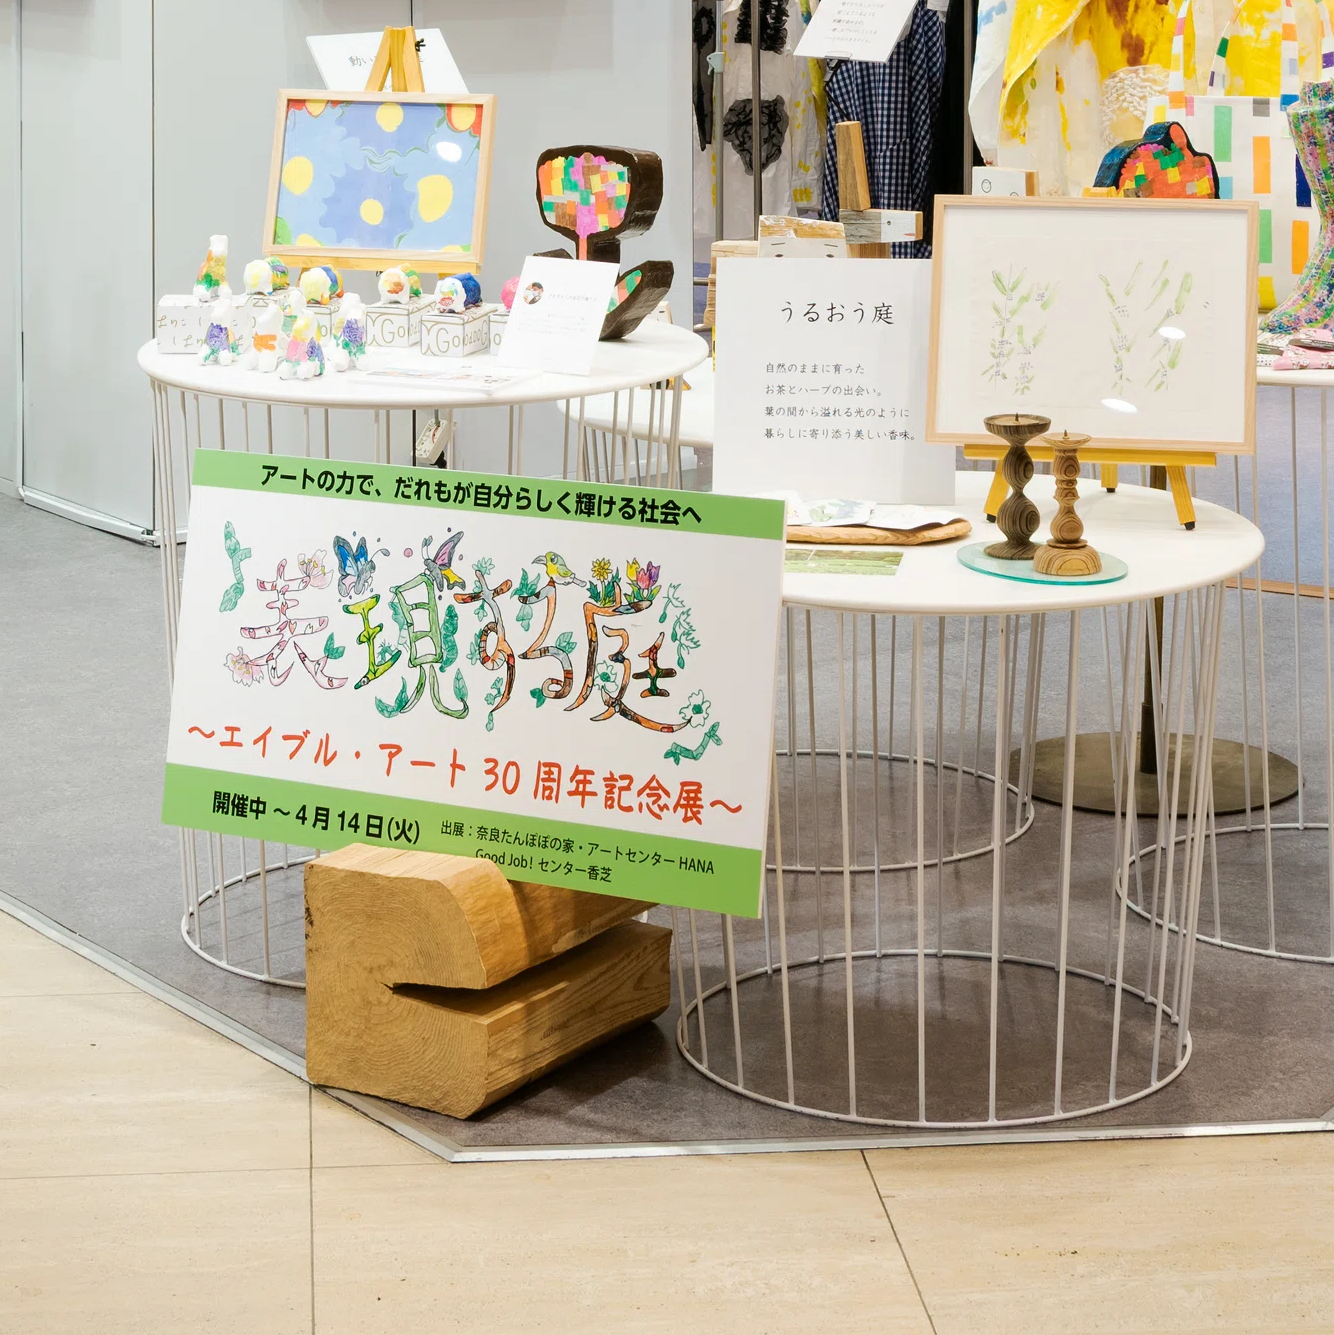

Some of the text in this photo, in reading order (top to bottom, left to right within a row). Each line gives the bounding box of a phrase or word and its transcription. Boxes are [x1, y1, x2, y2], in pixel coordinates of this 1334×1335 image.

[780, 301, 895, 325] うるおう庭
[765, 362, 865, 375] 自然のままに育った
[765, 384, 882, 397] お茶とハーブの出会い。
[764, 406, 910, 418] 葉の間から溢れる光のように
[764, 428, 915, 441] 暮らしに寄り添う美しい香味。
[261, 464, 702, 526] アートの力で、だれもが自分らしく輝ける社会へ
[508, 852, 533, 870] Job!
[538, 857, 613, 883] センター香芝
[678, 856, 715, 875] HANA
